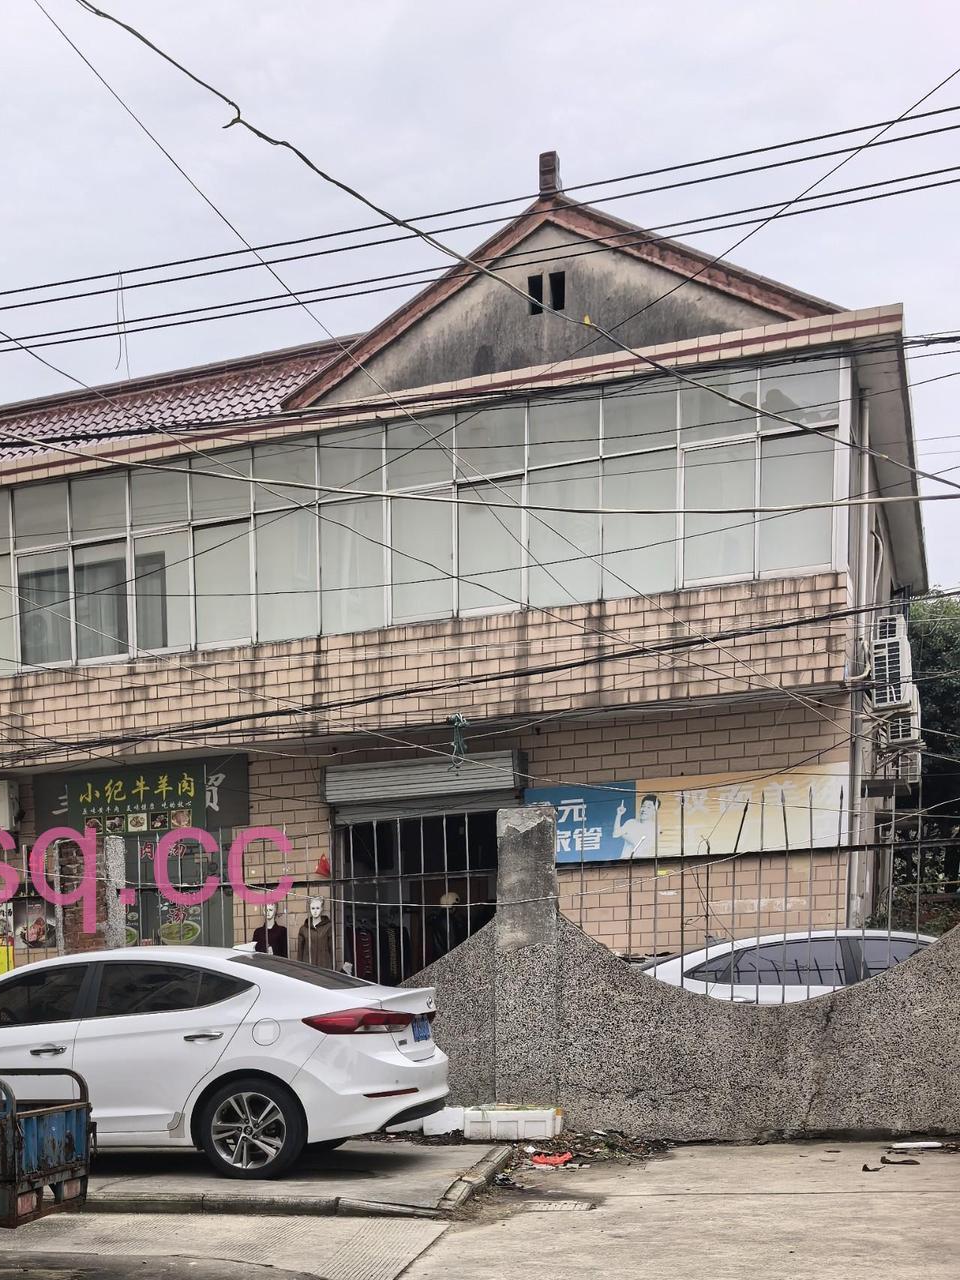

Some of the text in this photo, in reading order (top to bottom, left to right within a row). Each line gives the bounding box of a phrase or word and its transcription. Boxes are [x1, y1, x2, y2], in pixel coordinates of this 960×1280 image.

[79, 772, 196, 804] 小纪牛羊肉
